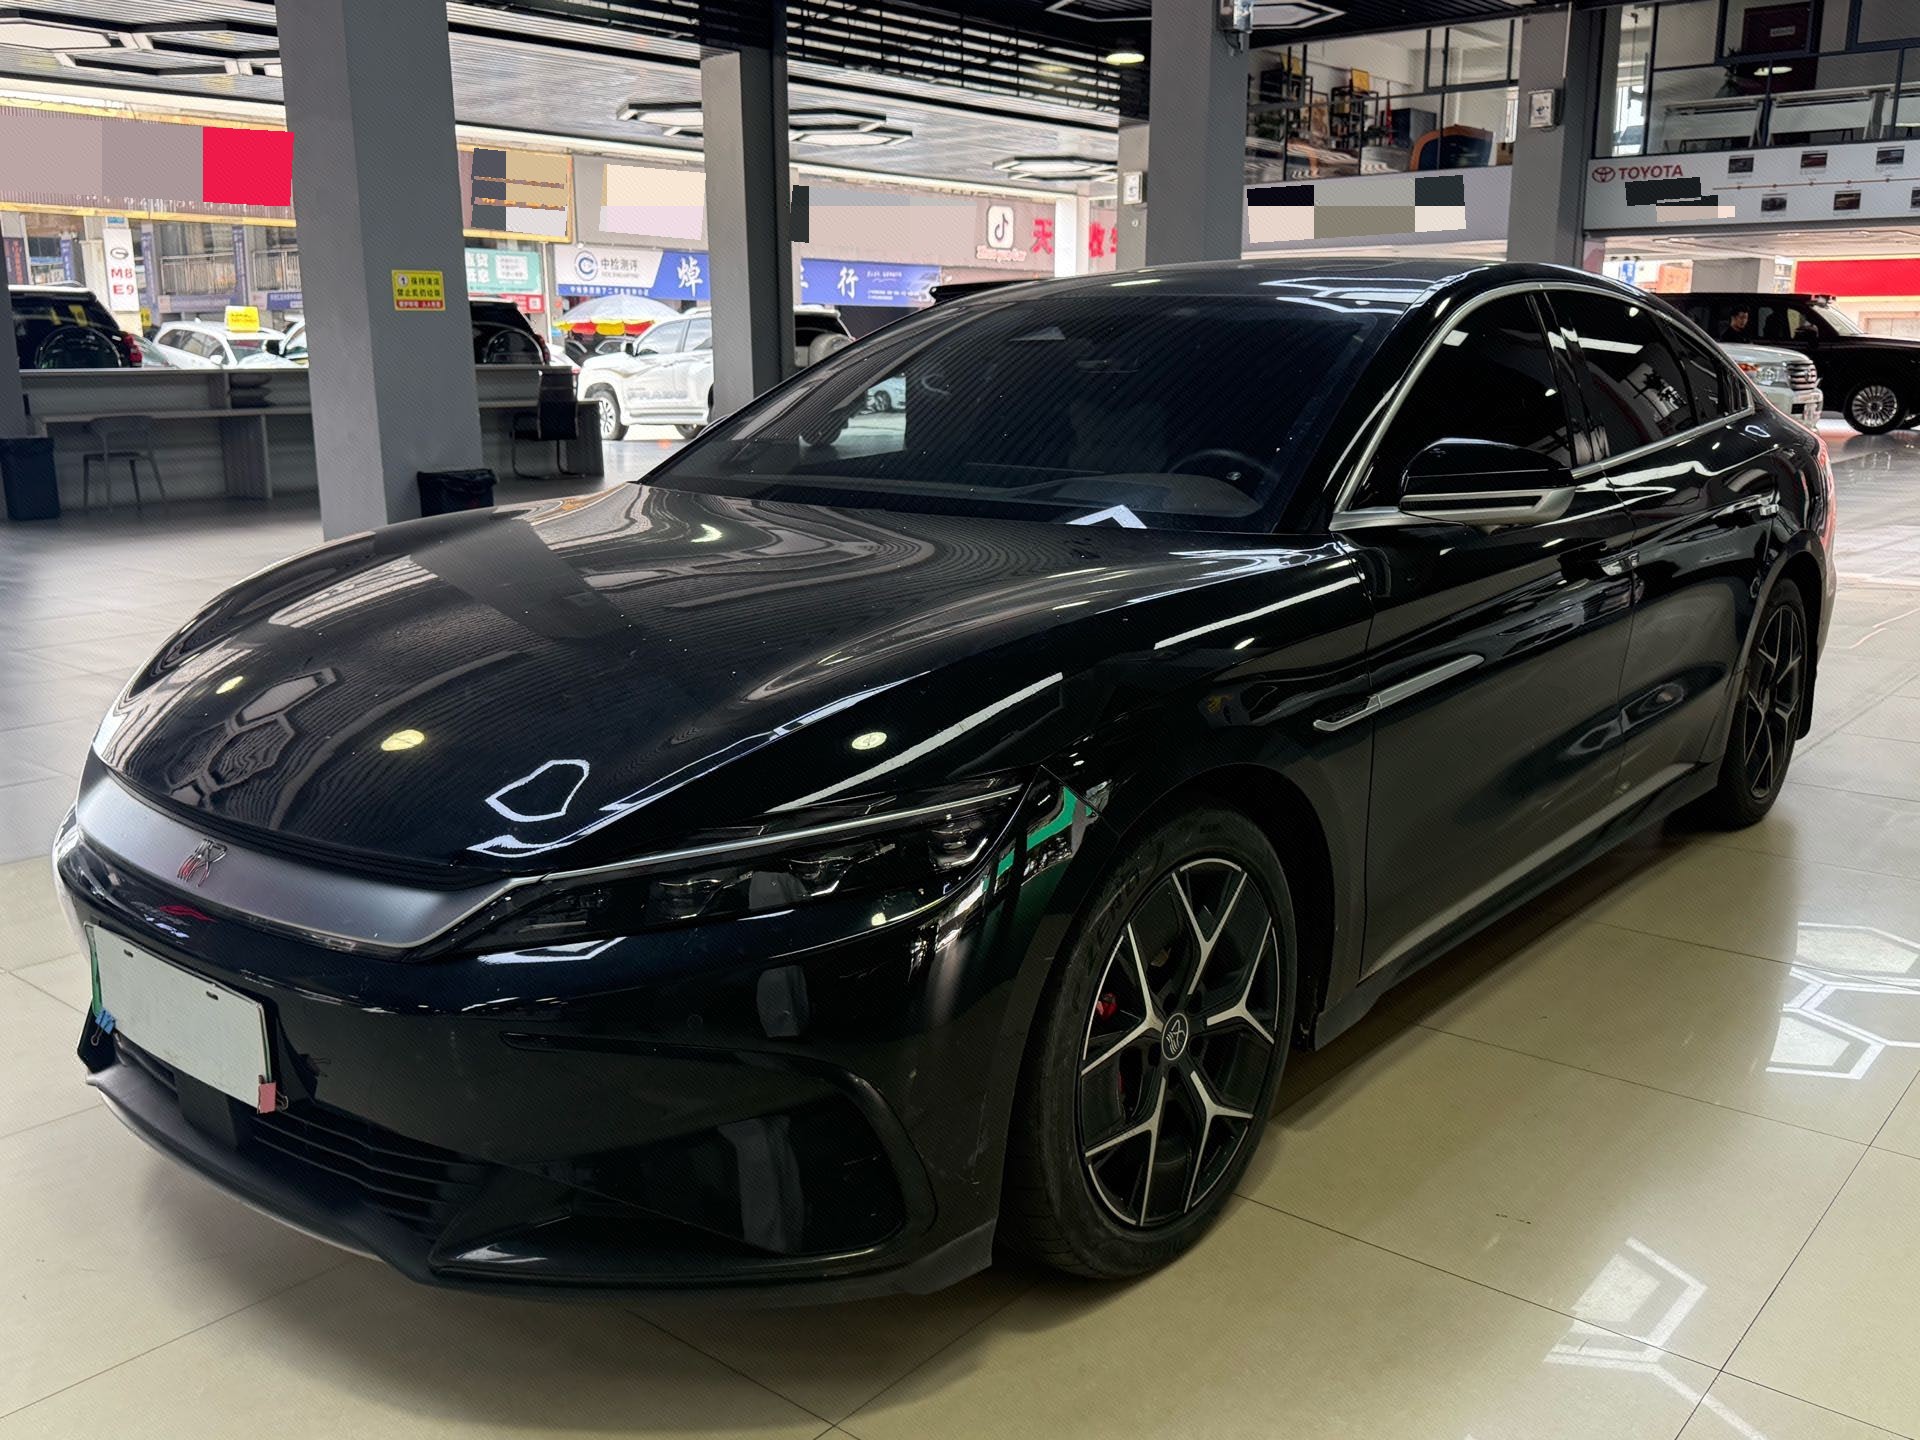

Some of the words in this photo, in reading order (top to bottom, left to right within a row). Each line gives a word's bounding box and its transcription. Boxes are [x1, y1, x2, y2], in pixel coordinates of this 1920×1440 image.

[1619, 165, 1683, 180] TOYOTA
[111, 268, 133, 279] M8
[837, 266, 859, 299] 行
[113, 285, 135, 296] E9
